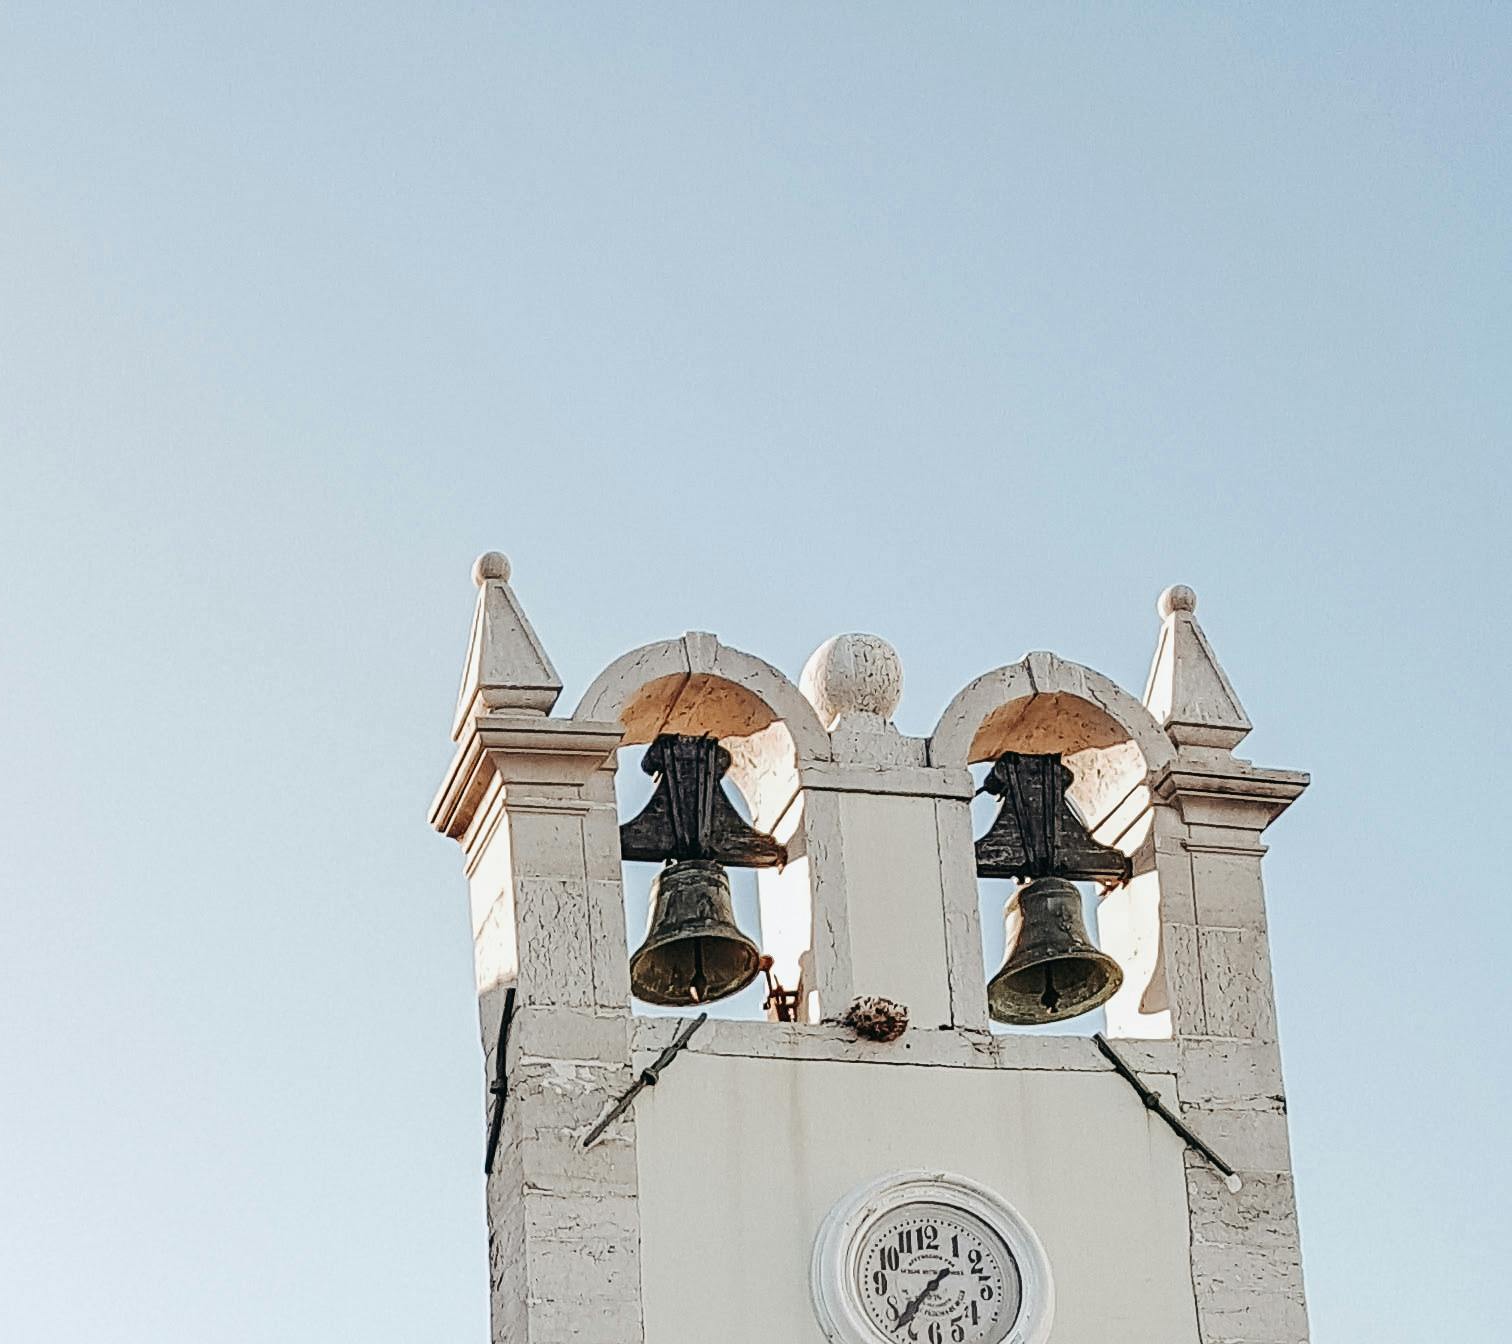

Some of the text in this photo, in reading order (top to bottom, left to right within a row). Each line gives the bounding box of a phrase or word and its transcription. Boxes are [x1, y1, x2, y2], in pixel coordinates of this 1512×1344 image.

[898, 1229, 913, 1254] 11
[916, 1225, 940, 1250] 12
[951, 1234, 960, 1258] 1
[880, 1245, 900, 1271] 10
[968, 1249, 984, 1274] 2
[873, 1271, 887, 1296] 9
[886, 1296, 899, 1321] 8
[951, 1316, 965, 1342] 5
